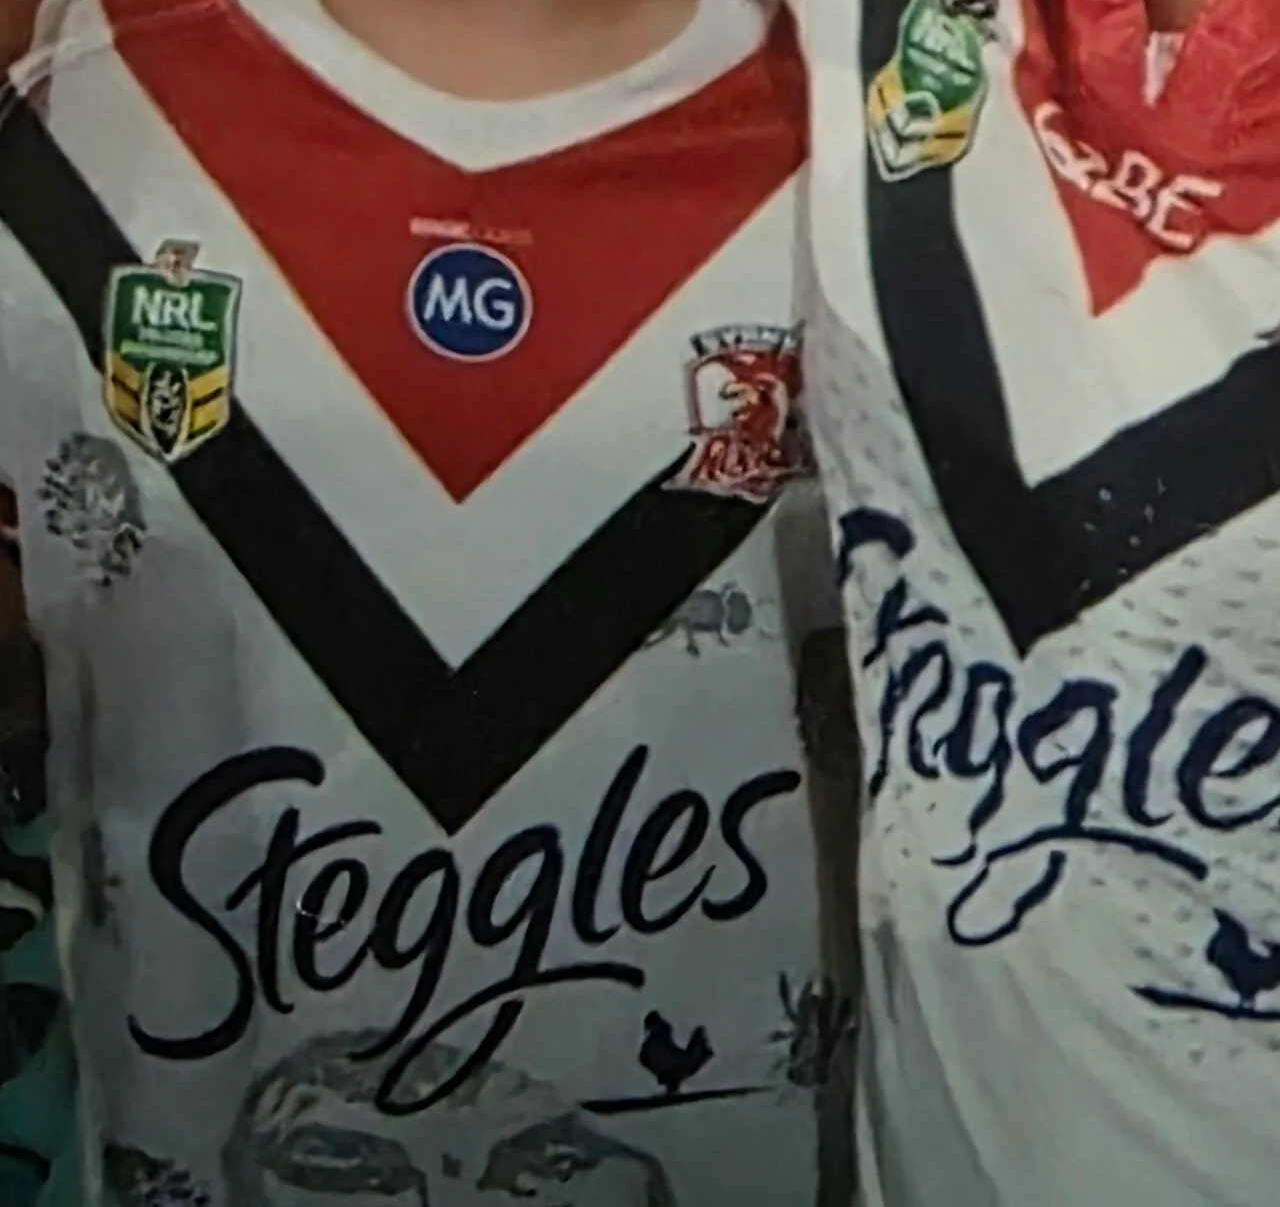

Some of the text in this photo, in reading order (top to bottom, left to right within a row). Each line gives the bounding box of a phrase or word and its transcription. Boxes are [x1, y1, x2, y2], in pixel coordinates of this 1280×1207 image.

[131, 284, 217, 330] NRL
[423, 272, 516, 331] MG
[127, 743, 803, 1115] Steggles
